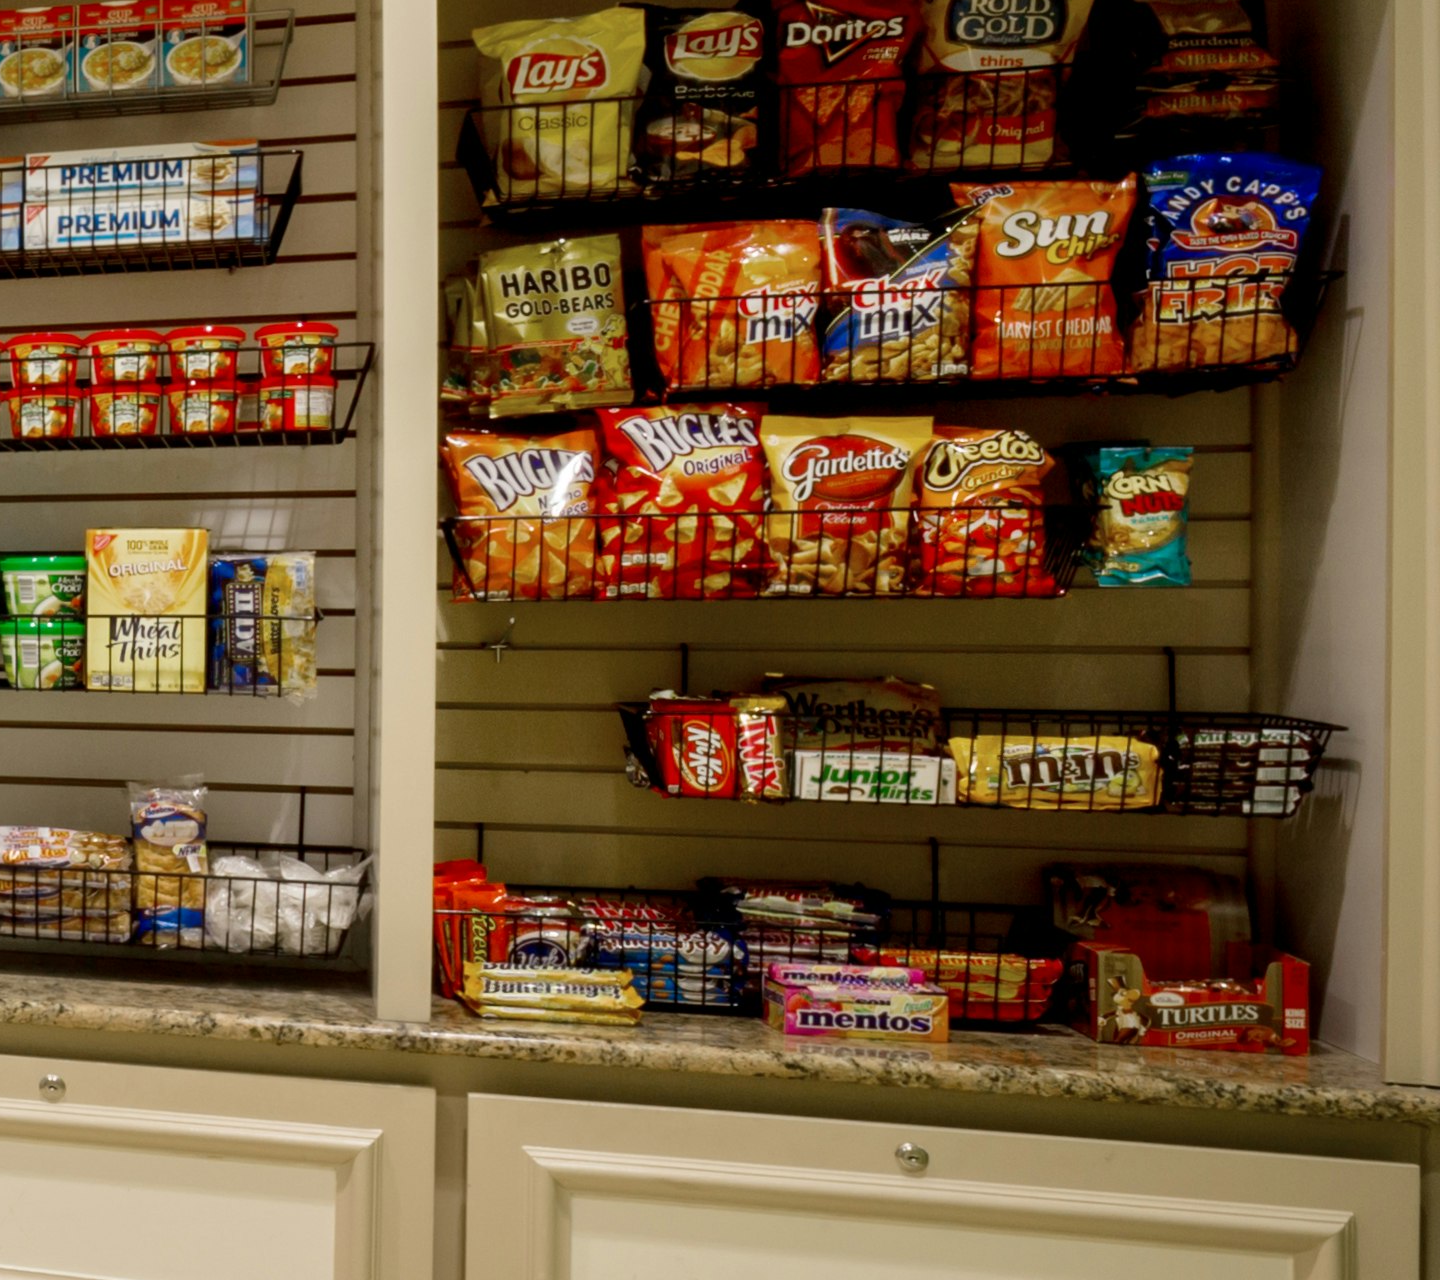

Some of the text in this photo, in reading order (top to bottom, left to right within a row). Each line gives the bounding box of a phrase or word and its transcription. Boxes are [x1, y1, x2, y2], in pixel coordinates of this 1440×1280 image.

[673, 22, 760, 60] Lay's
[786, 16, 904, 48] Doritos
[955, 15, 1054, 42] GOLD
[980, 55, 1024, 69] thins
[1175, 50, 1260, 67] NIBBLERS
[512, 52, 598, 95] Lay's
[518, 112, 588, 132] Classic
[987, 122, 1045, 140] Orignal
[60, 160, 182, 187] PREMIUM
[1164, 176, 1306, 221] ANDY CAPP'S
[58, 209, 180, 236] PREMIUM
[996, 210, 1108, 257] Sun
[1046, 232, 1119, 265] Chips
[500, 262, 611, 299] HARIBO
[854, 266, 945, 312] Chex
[505, 293, 615, 319] GOLD-BEARS
[739, 281, 818, 317] Chex
[1158, 282, 1286, 322] FRIES
[745, 313, 815, 345] mix
[861, 297, 941, 339] mix
[622, 413, 759, 472] BUGLES
[683, 448, 753, 477] ORIGINAL
[783, 445, 909, 502] Gardetto's
[924, 433, 1042, 488] Cheetos
[467, 449, 595, 512] BUGLS
[963, 466, 1025, 491] Crunchy
[1107, 473, 1174, 500] CORN
[1121, 494, 1183, 517] NUTS
[109, 559, 187, 578] ORIGINAL
[111, 615, 181, 642] Wheat
[106, 642, 181, 663] Thins
[784, 690, 933, 722] Werther's
[811, 763, 917, 786] Junior
[867, 785, 934, 803] Mints
[177, 845, 201, 858] NEW!
[783, 970, 868, 984] mentos
[799, 1009, 932, 1034] mentos
[1157, 1004, 1259, 1027] TURTLES
[1285, 1009, 1305, 1020] KING
[1285, 1019, 1306, 1030] SIZE
[1175, 1028, 1237, 1042] ORIGINAL
